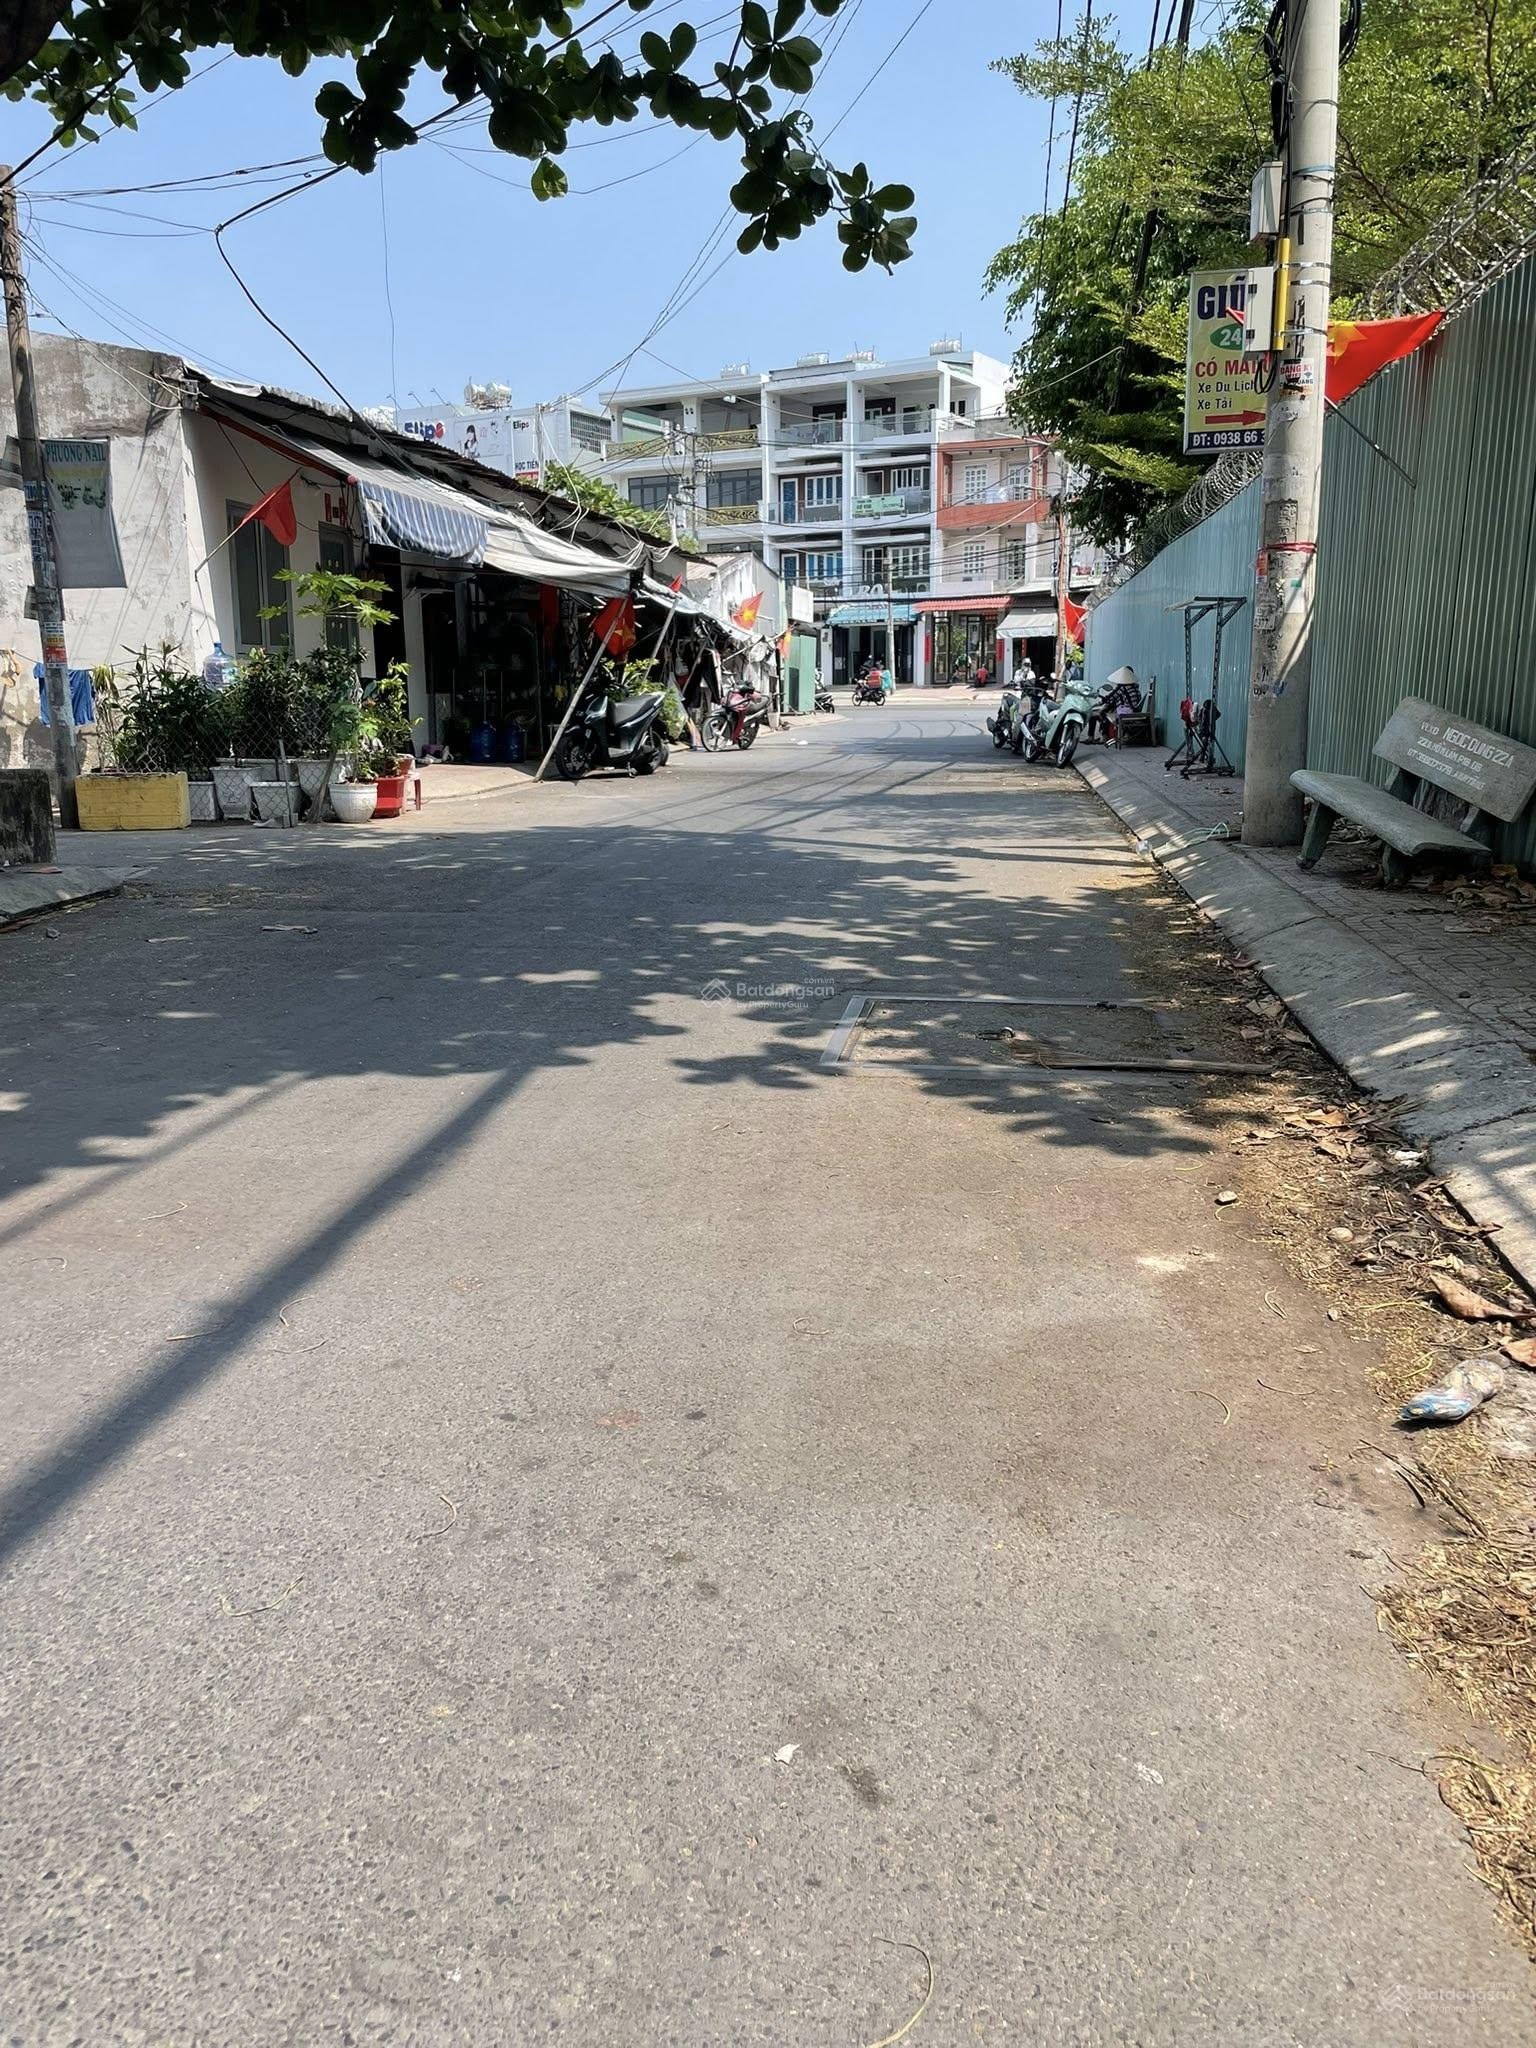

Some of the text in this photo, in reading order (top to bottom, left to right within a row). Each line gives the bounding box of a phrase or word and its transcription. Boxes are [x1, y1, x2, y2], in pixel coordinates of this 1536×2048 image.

[1195, 357, 1217, 377] CÓ
[1198, 383, 1211, 393] Xe
[1216, 381, 1230, 392] Du
[1197, 397, 1232, 410] Xe Tải
[1193, 434, 1211, 446] ĐT:
[1214, 431, 1240, 445] 0938
[1244, 431, 1257, 443] 66
